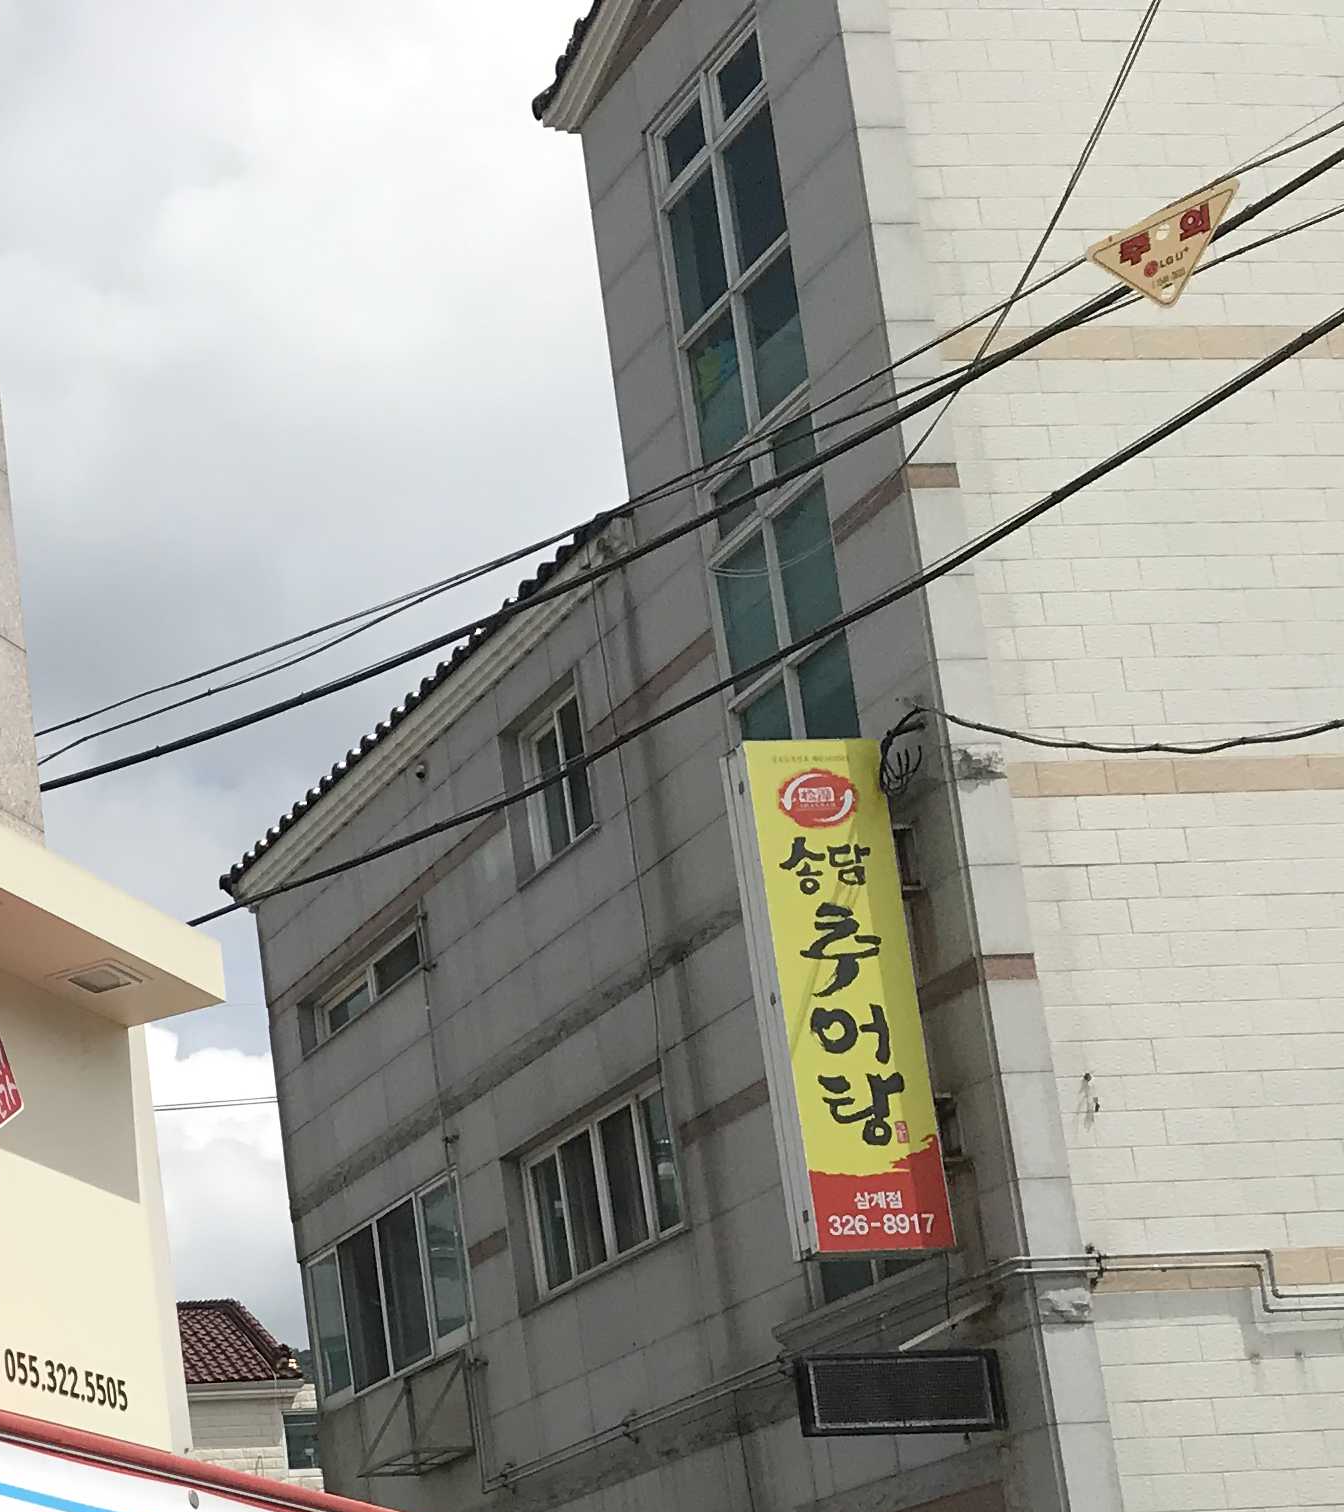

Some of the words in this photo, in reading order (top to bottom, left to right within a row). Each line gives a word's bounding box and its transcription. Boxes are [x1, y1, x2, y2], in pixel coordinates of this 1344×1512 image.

[779, 836, 871, 895] 송담
[800, 901, 906, 1146] 추어탕
[828, 1213, 934, 1235] 326-8917
[854, 1190, 903, 1210] 삼계점
[4, 1347, 128, 1412] 055.322.5505
